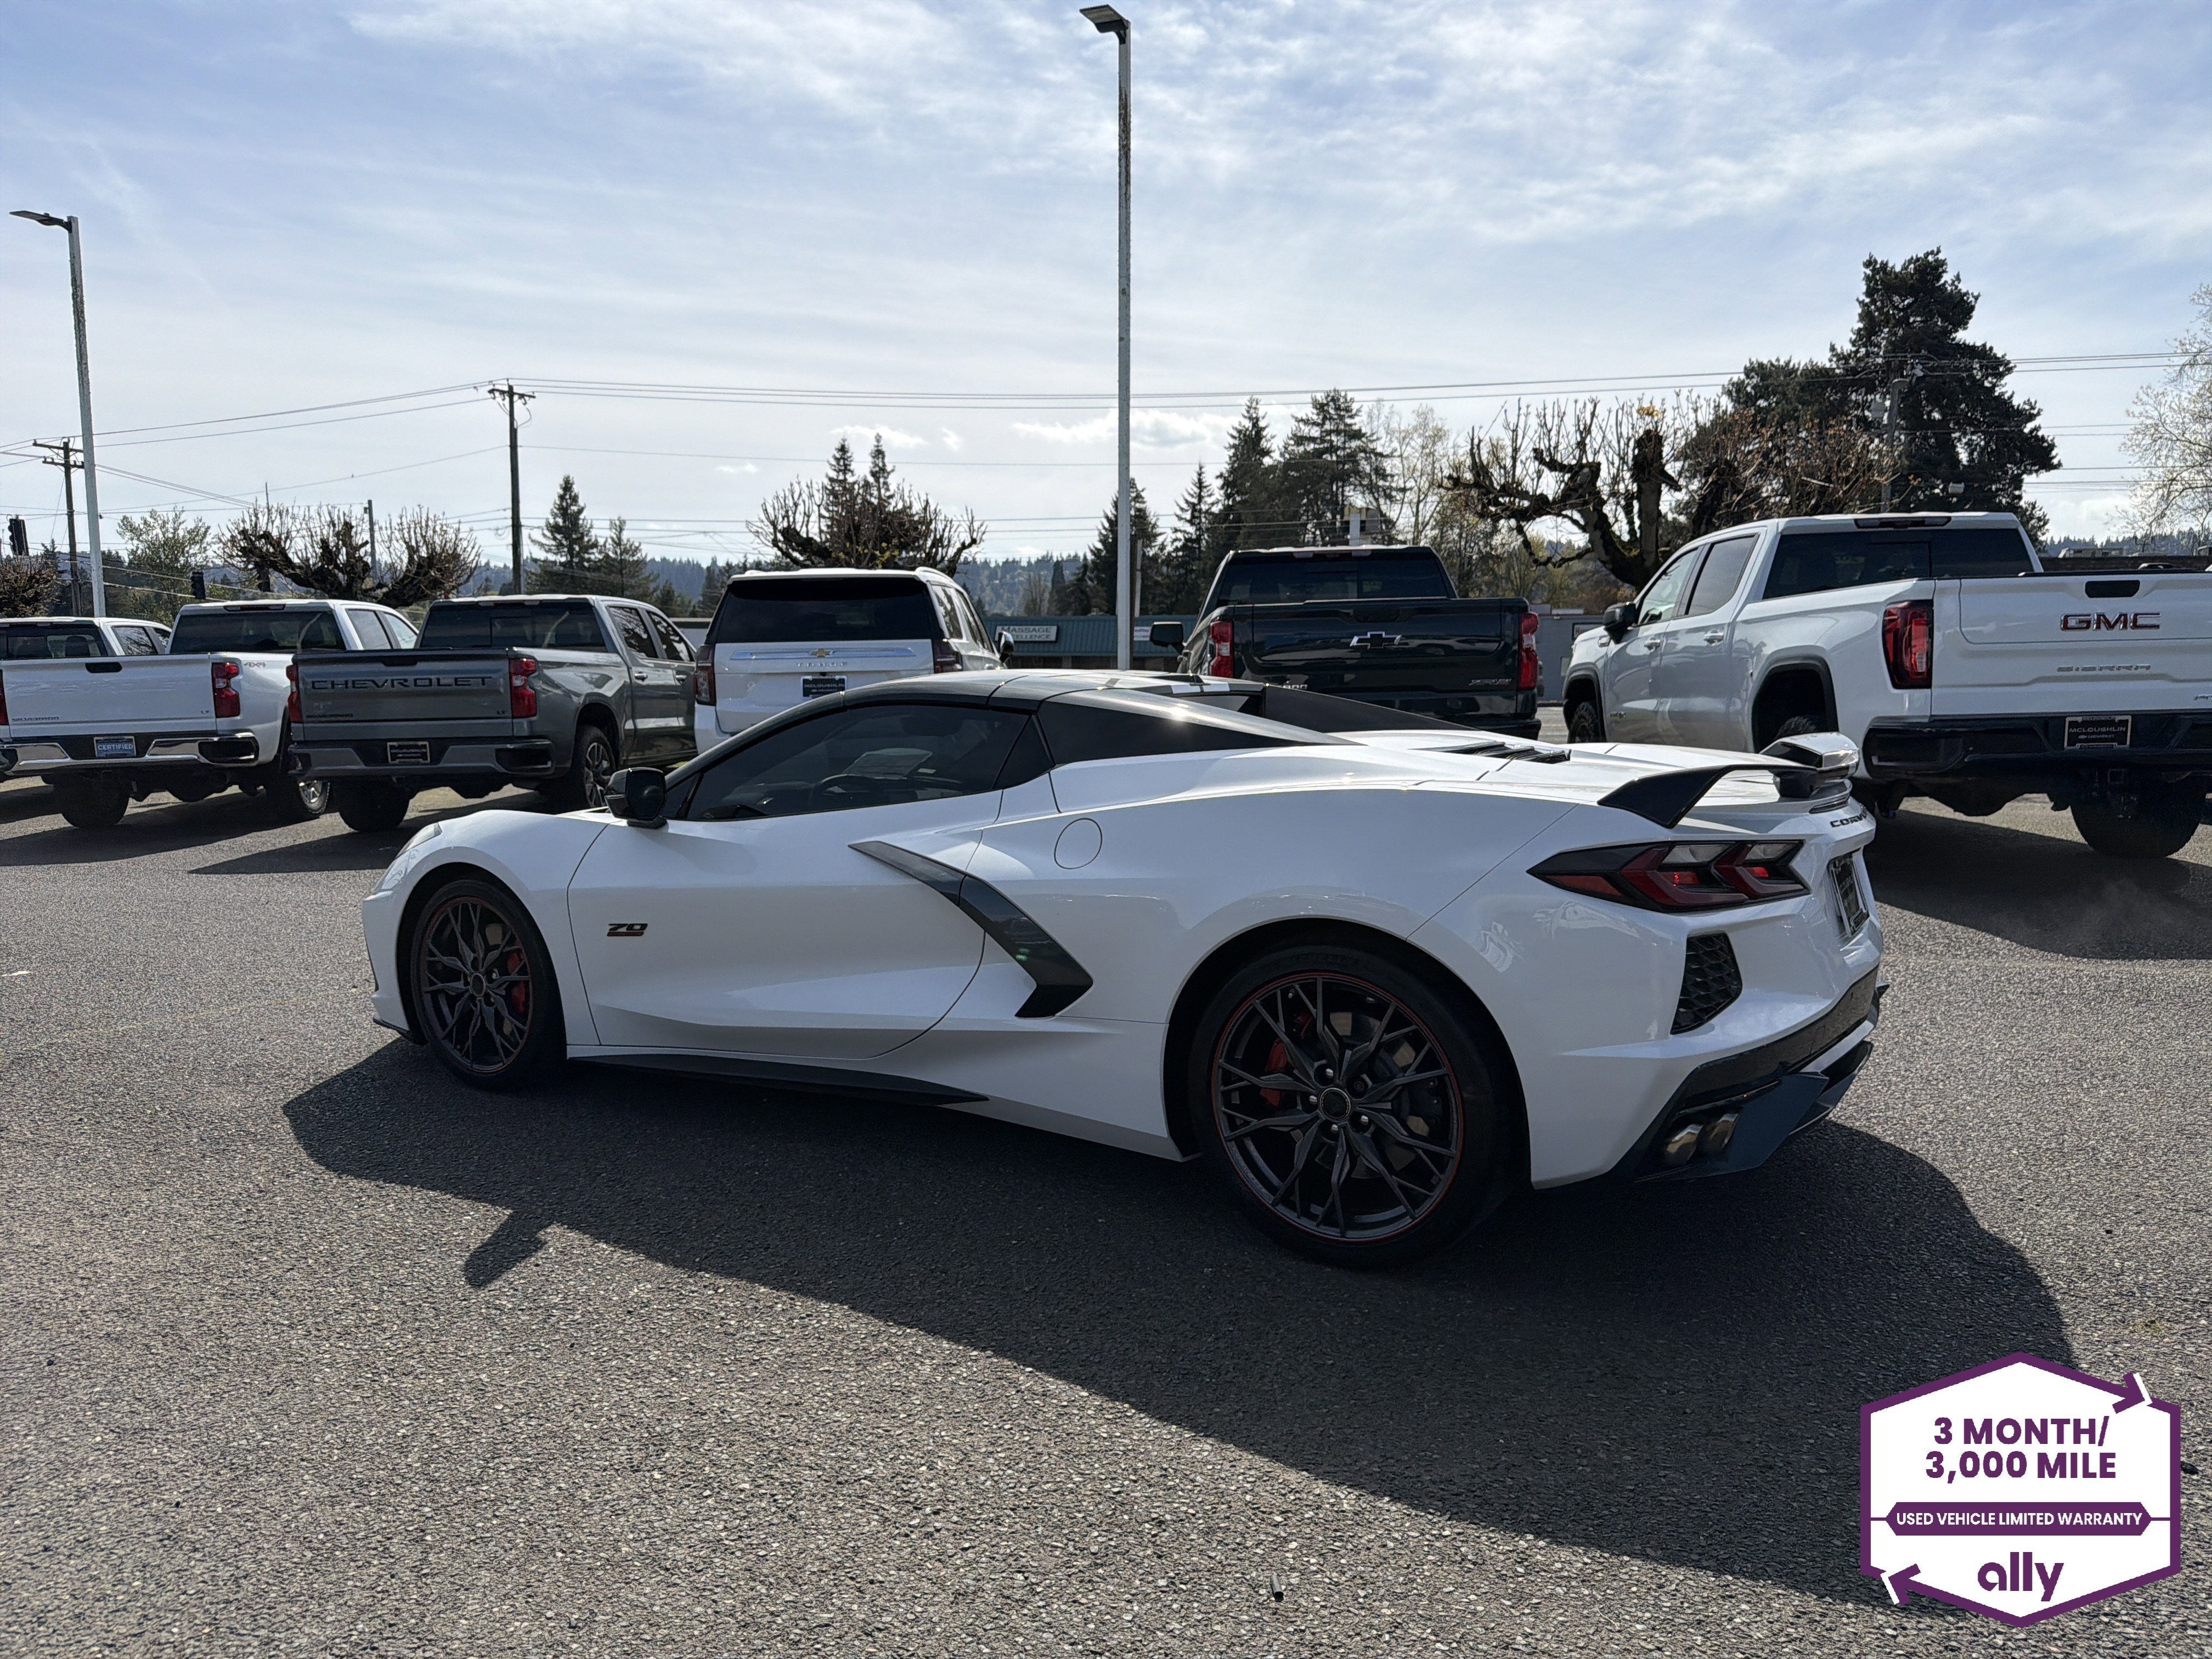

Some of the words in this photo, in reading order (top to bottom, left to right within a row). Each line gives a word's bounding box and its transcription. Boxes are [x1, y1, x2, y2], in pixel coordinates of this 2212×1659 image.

[2061, 612, 2160, 631] GMC
[2057, 664, 2151, 672] SIERRA
[311, 676, 493, 690] CHEVROLET
